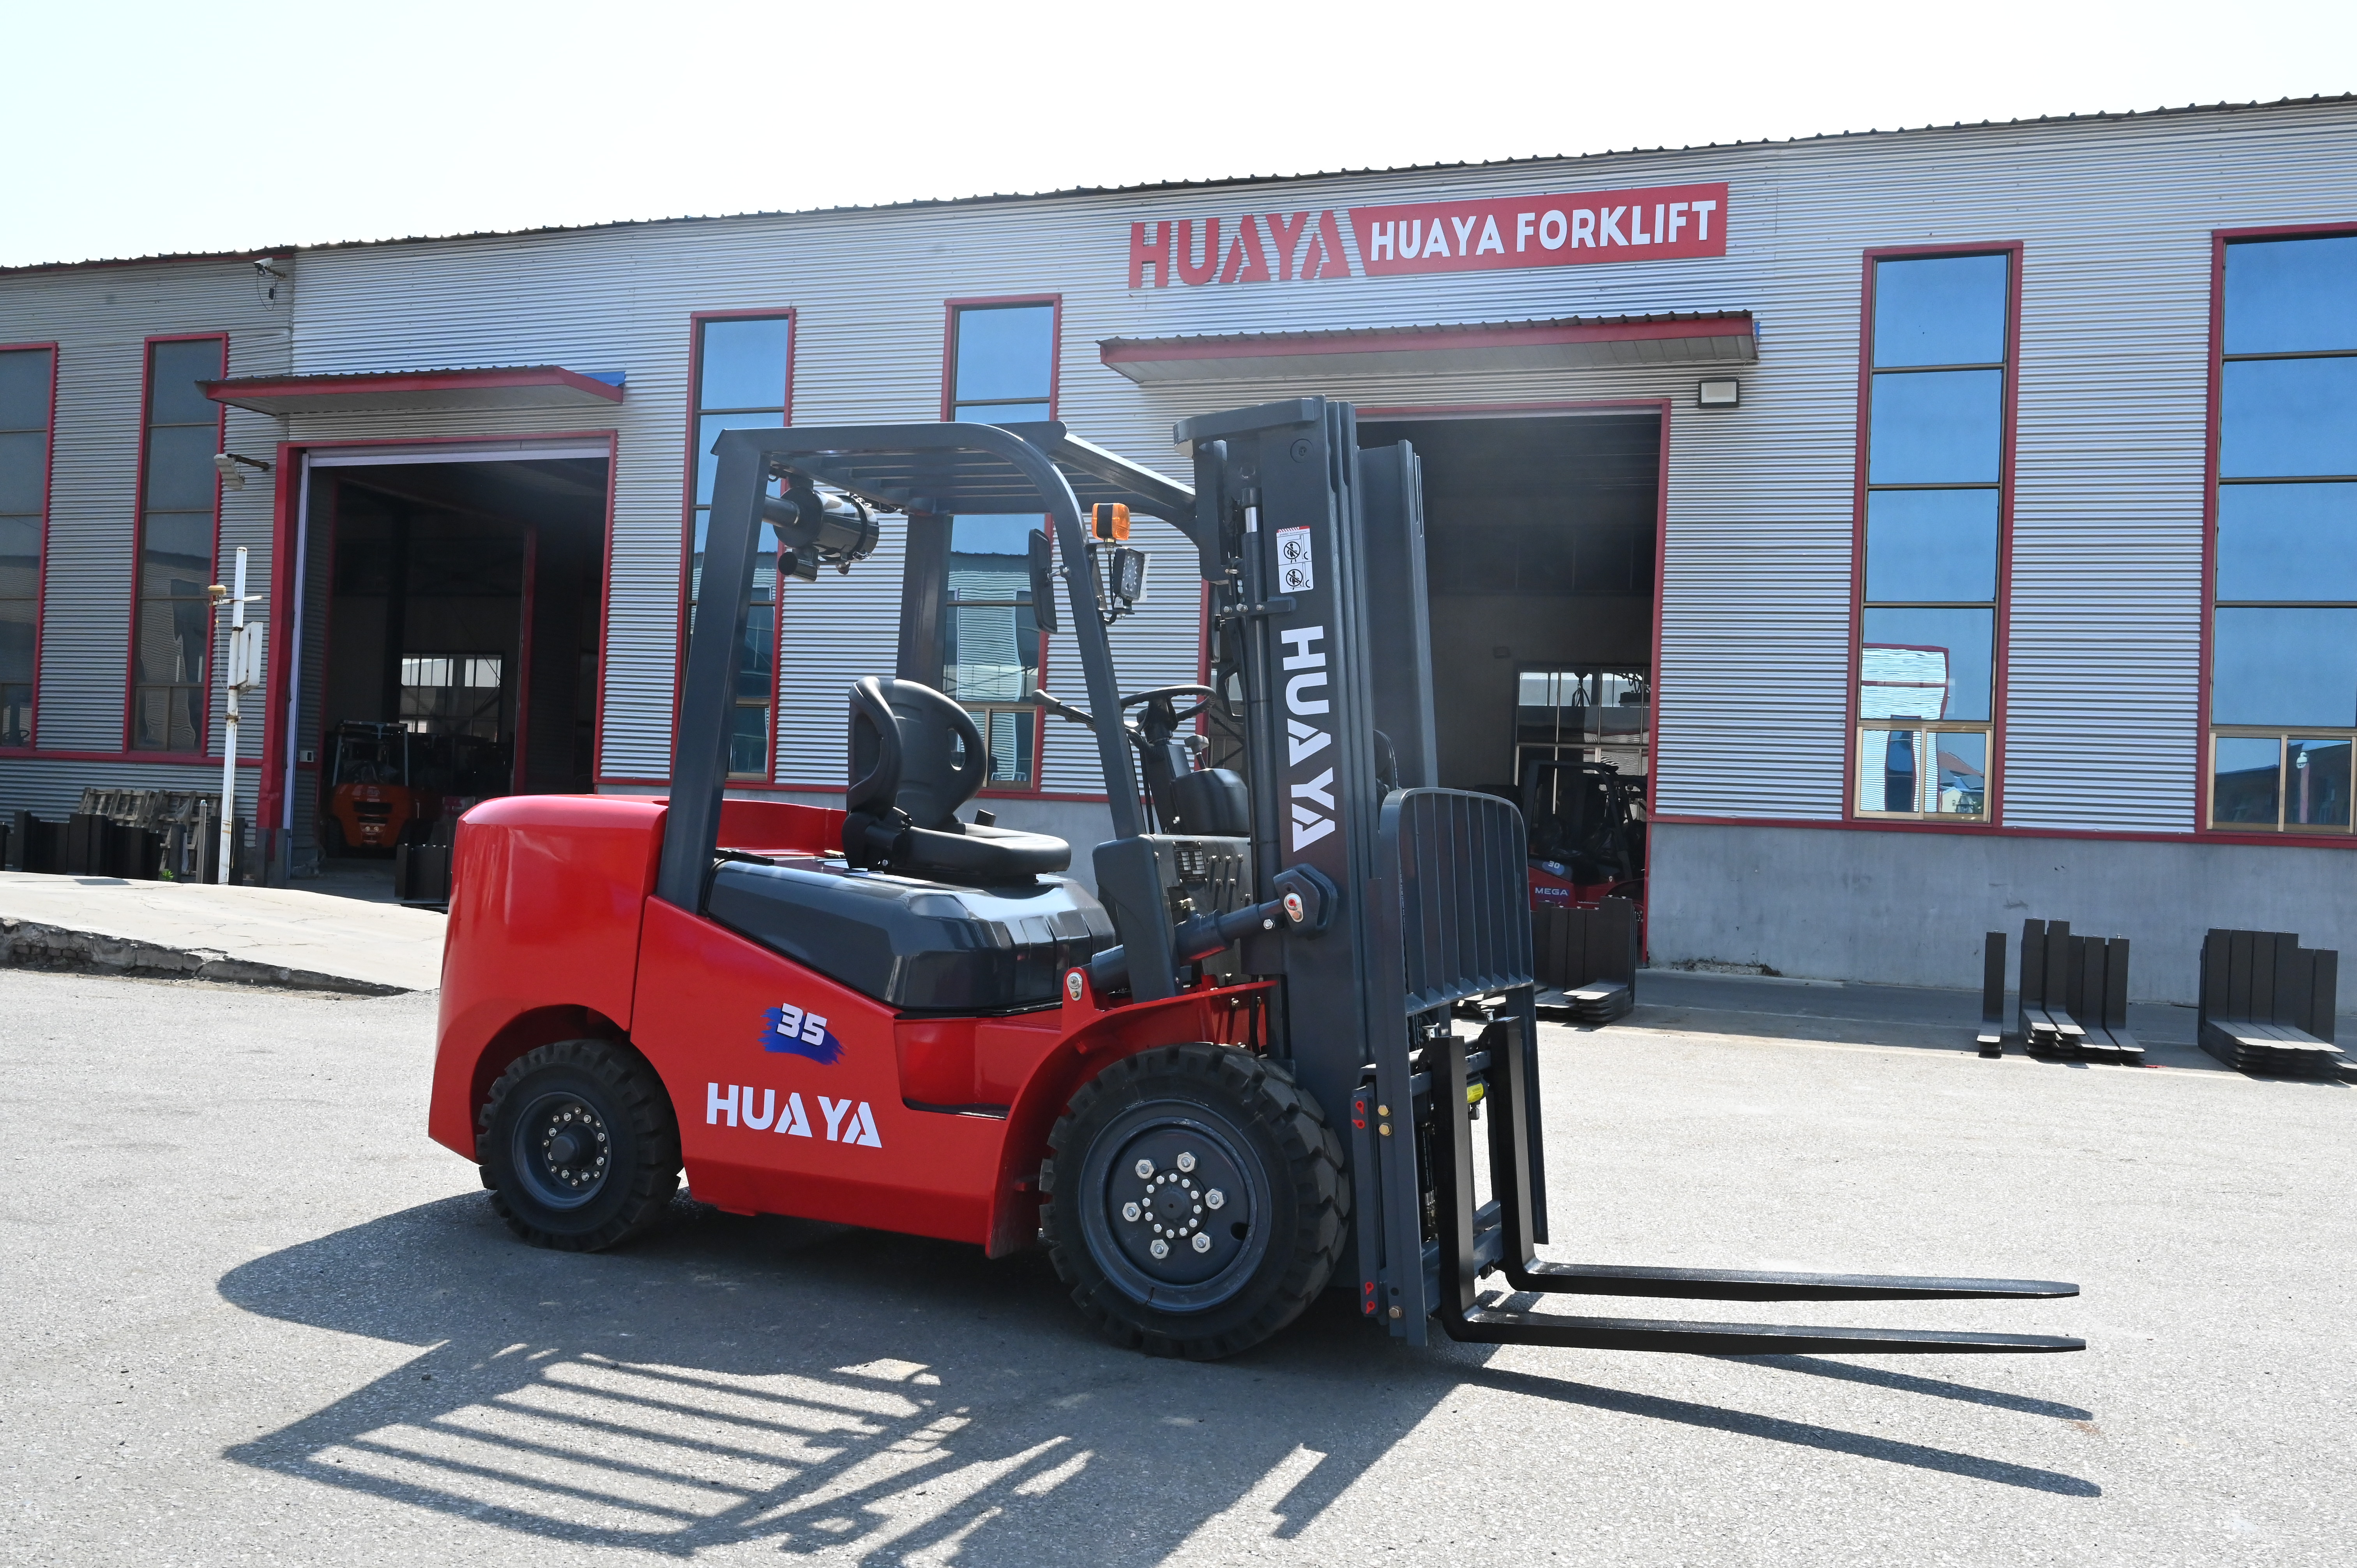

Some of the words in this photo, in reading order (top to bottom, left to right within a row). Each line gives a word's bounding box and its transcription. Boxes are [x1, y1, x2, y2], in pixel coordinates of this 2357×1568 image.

[1128, 210, 1351, 288] HUAYA
[1371, 214, 1505, 261] HUAYA
[1516, 200, 1716, 253] FORKLIFT
[1281, 625, 1336, 853] HUAYA
[1535, 887, 1568, 896] MEGA
[1548, 860, 1560, 869] 30
[776, 1003, 827, 1046] 35
[706, 1082, 882, 1148] HUAYA
